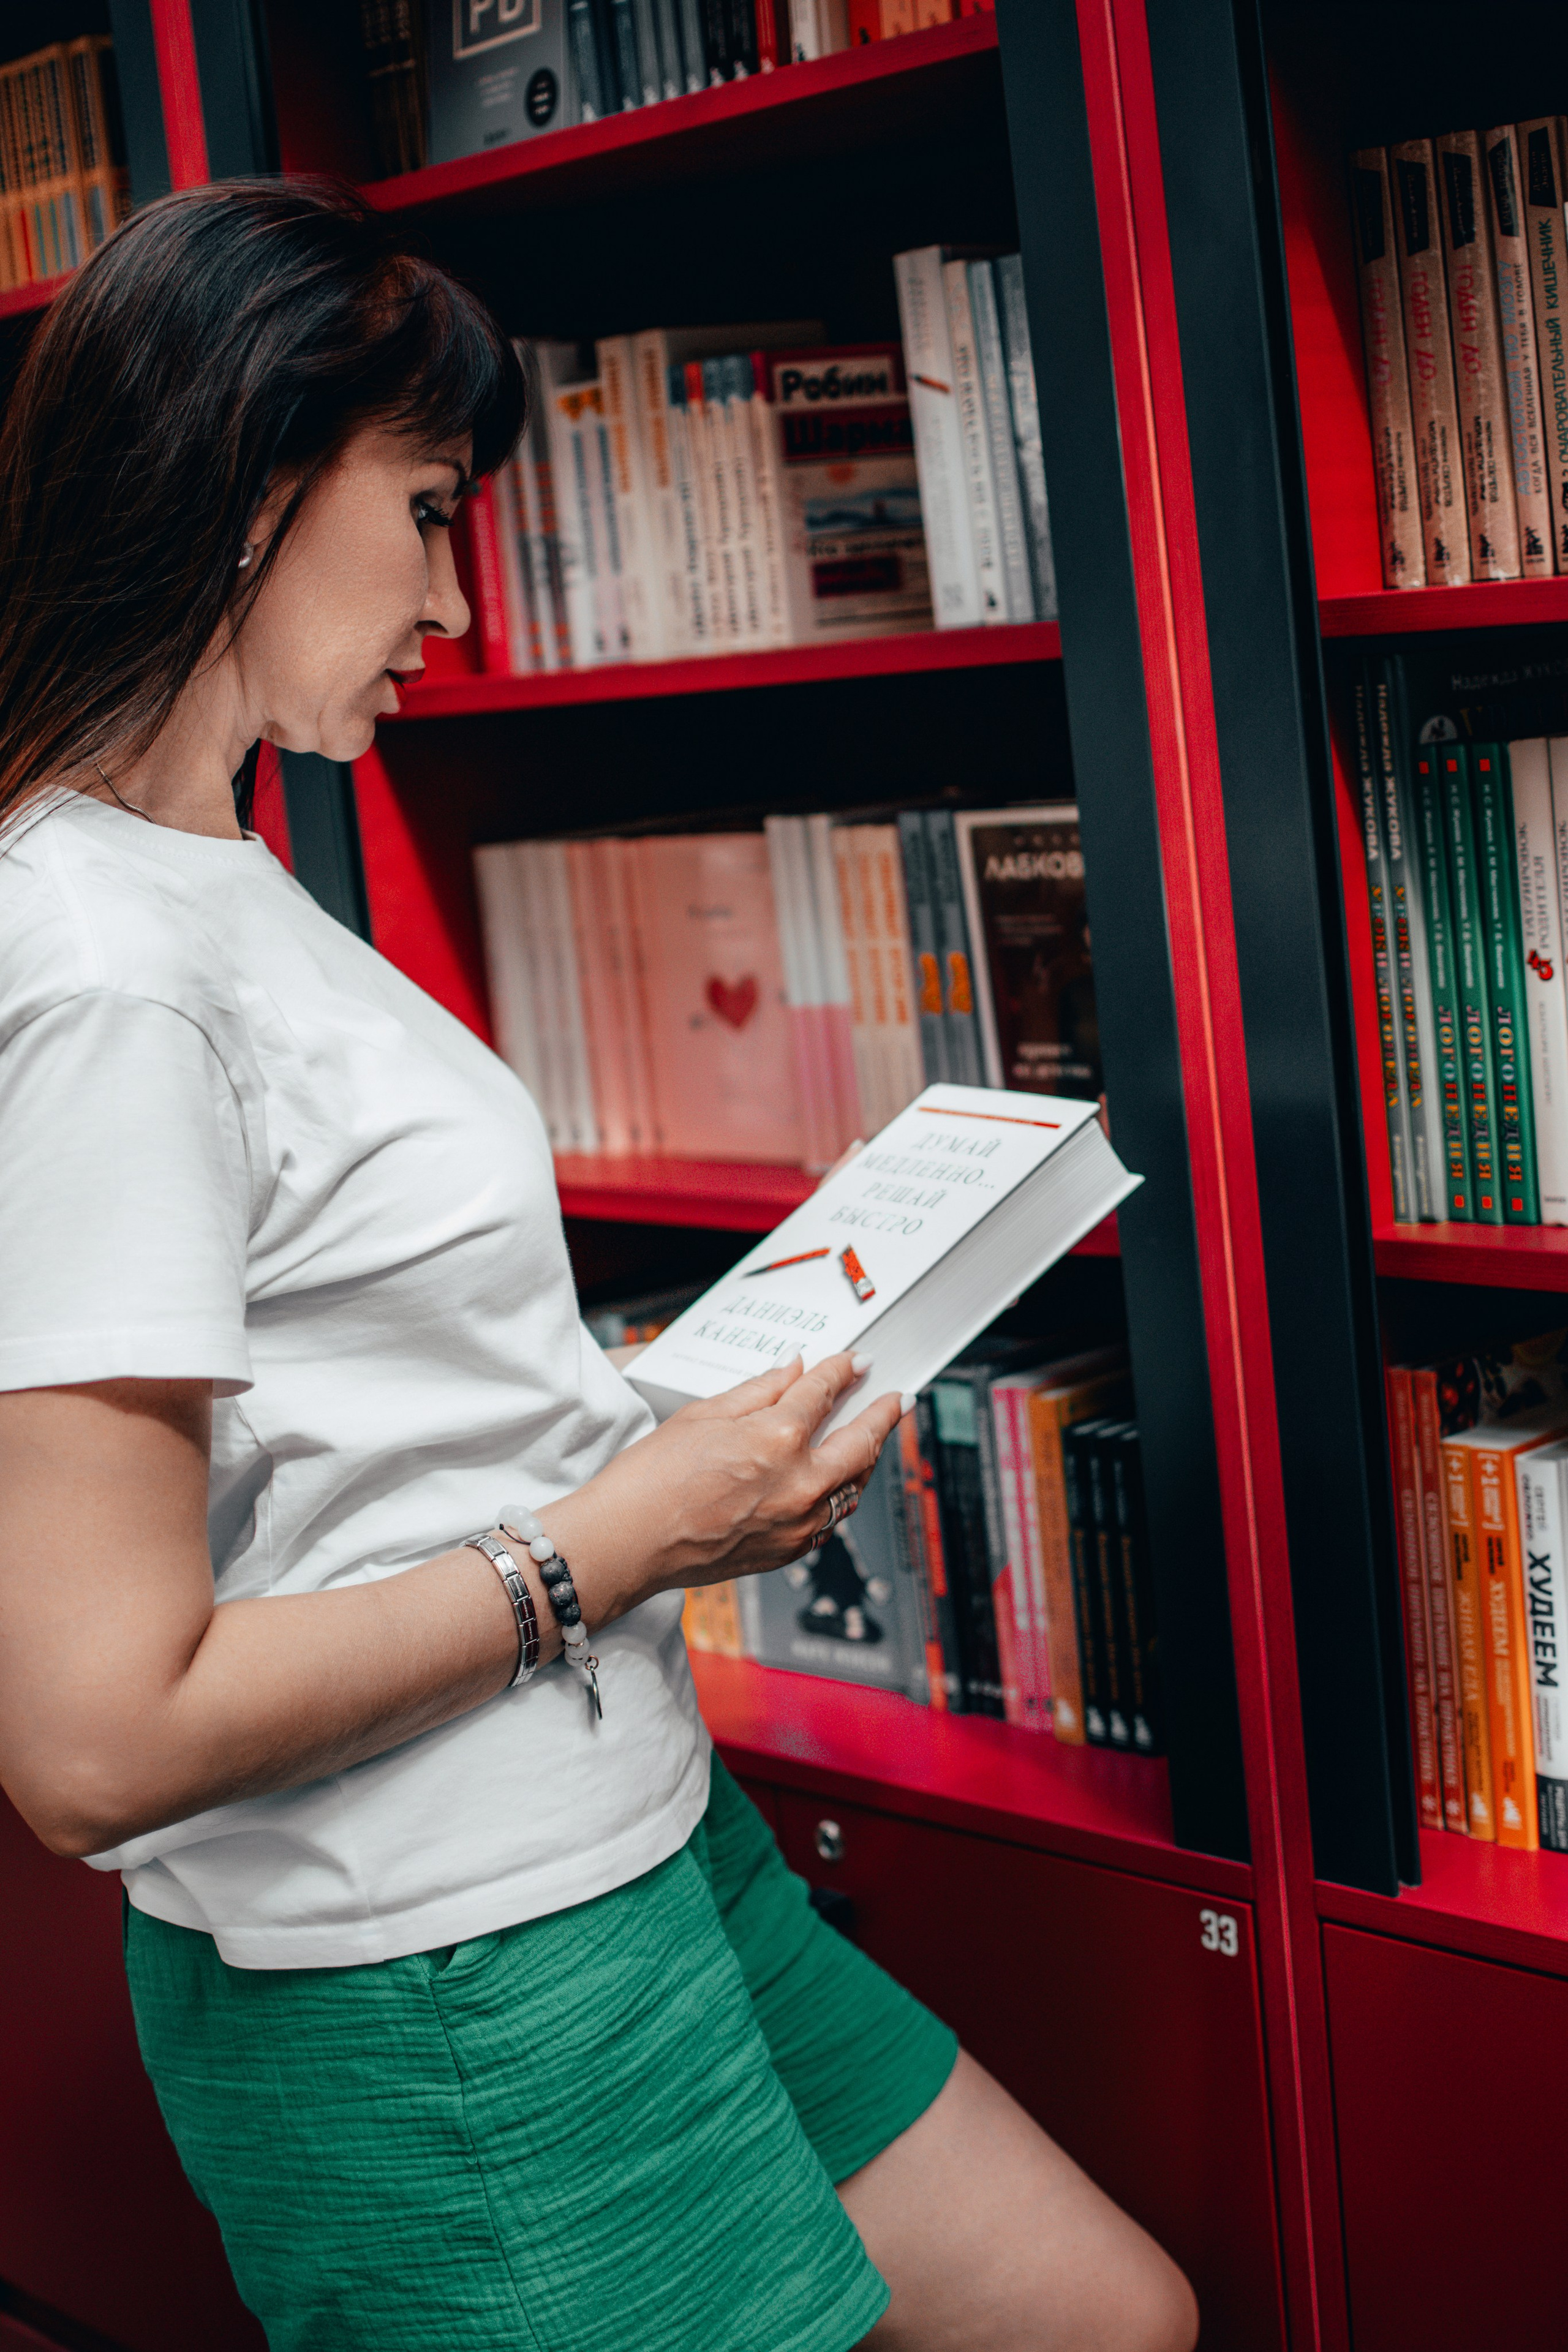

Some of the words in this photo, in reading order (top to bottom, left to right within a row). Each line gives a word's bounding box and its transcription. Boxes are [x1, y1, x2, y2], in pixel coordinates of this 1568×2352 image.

[1497, 260, 1517, 325] МОЗГУ
[1539, 217, 1560, 309] КИШЕЧНИК
[1503, 334, 1520, 361] ПО
[781, 365, 888, 402] Робин
[1525, 368, 1536, 428] ВСЕЛЕННАЯ
[1545, 317, 1568, 464] ОЧАРОВАТЕЛЬНЫЙ
[785, 417, 913, 456] Шарма
[1508, 371, 1531, 496] АВТОСТОПОМ
[1377, 684, 1393, 772] Надежда
[1362, 775, 1379, 861] ЖУКОВА
[1384, 775, 1402, 861] ЖУКОВА
[1518, 823, 1534, 937] ТАТУИРОВОК
[1438, 1005, 1464, 1180] ЛОГОПЕДИЯ
[1466, 1005, 1493, 1180] ЛОГОПЕДИЯ
[1496, 1005, 1524, 1182] ЛОГОПЕДИЯ
[856, 1152, 995, 1189] МЕДЛЕННО...
[911, 1131, 1001, 1158] ДУМАЙ
[829, 1205, 924, 1235] БЫСТРО
[861, 1182, 948, 1209] РЕШАЙ
[693, 1319, 808, 1356] КАНЕМА
[722, 1296, 829, 1333] ДАНИЭЛЬ
[1528, 1549, 1558, 1689] ХУДЕЕМ
[1200, 1909, 1238, 1956] 33
